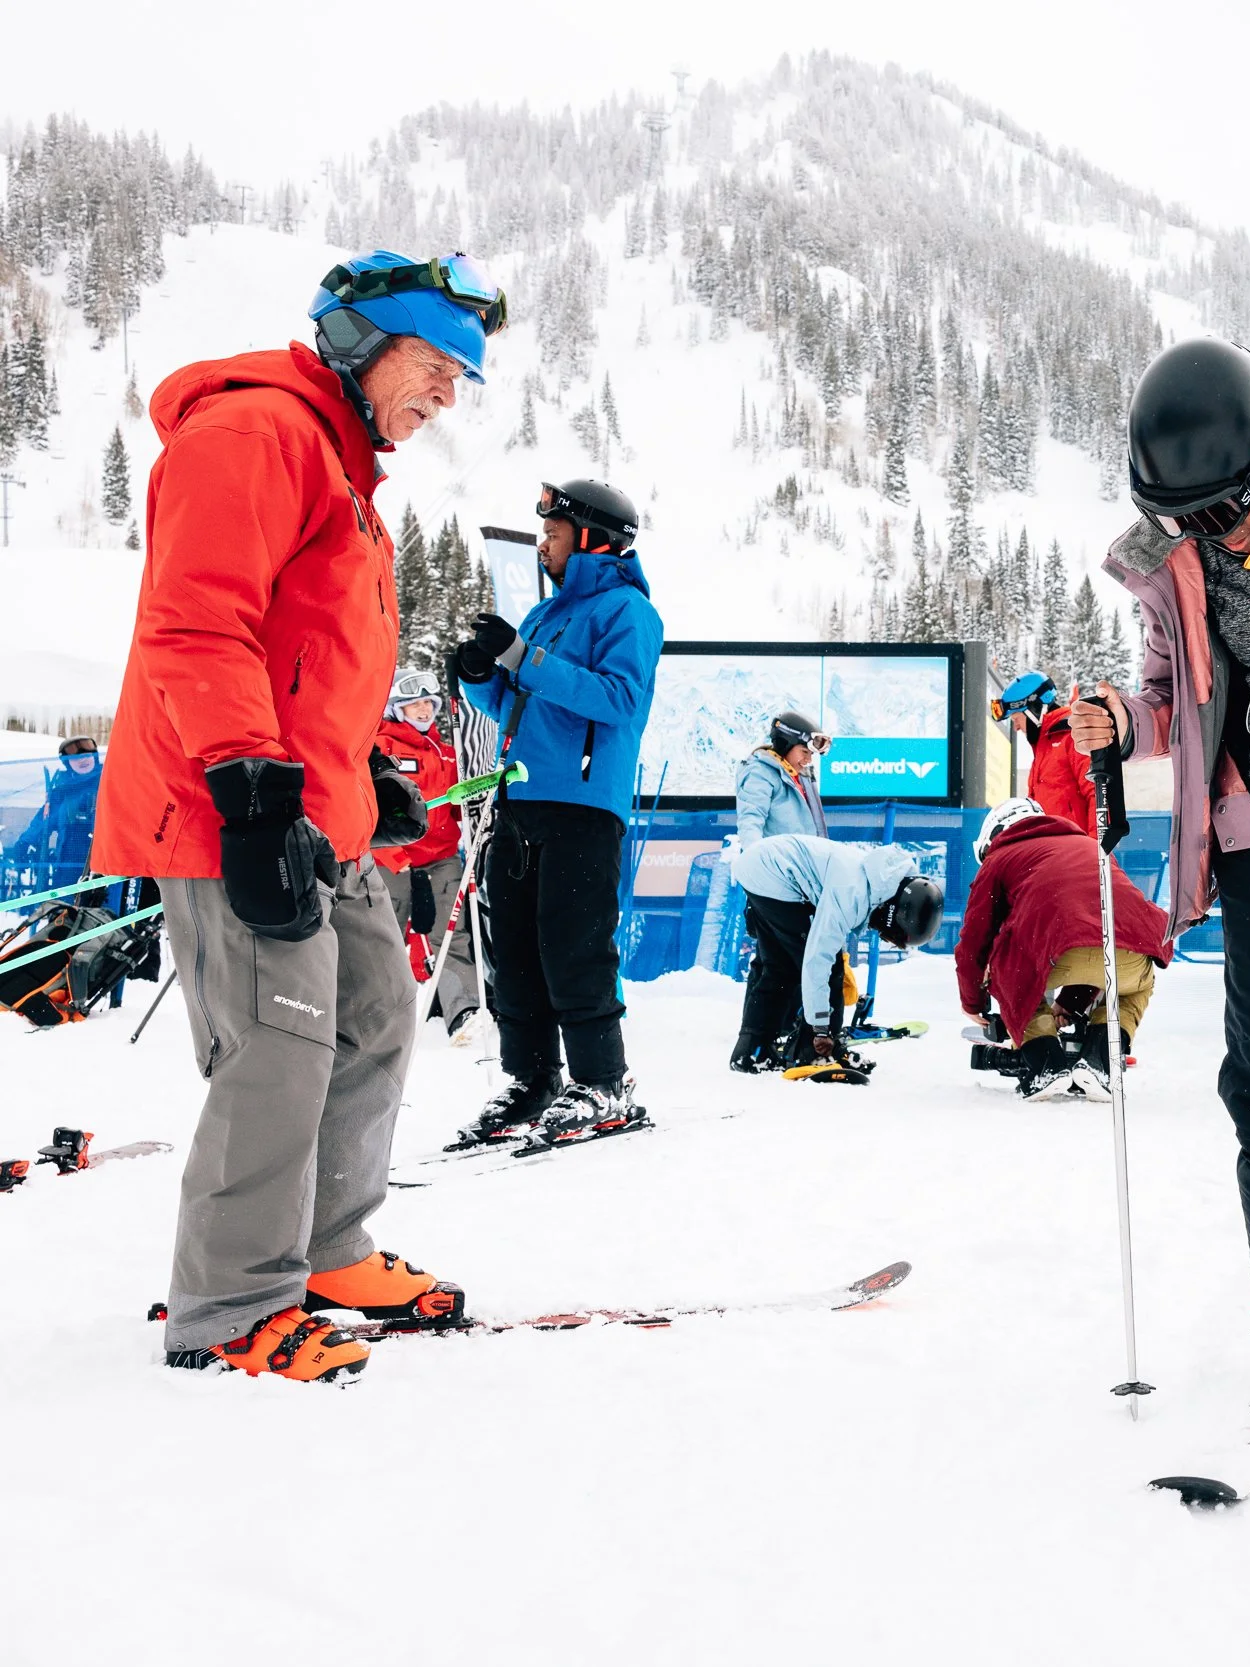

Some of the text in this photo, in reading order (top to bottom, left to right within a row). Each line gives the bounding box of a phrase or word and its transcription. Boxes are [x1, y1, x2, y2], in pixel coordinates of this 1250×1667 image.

[831, 758, 906, 775] snowbird
[640, 852, 691, 868] owder
[278, 857, 290, 890] HESTRA
[886, 904, 896, 928] SMITH
[273, 995, 313, 1013] snowbird
